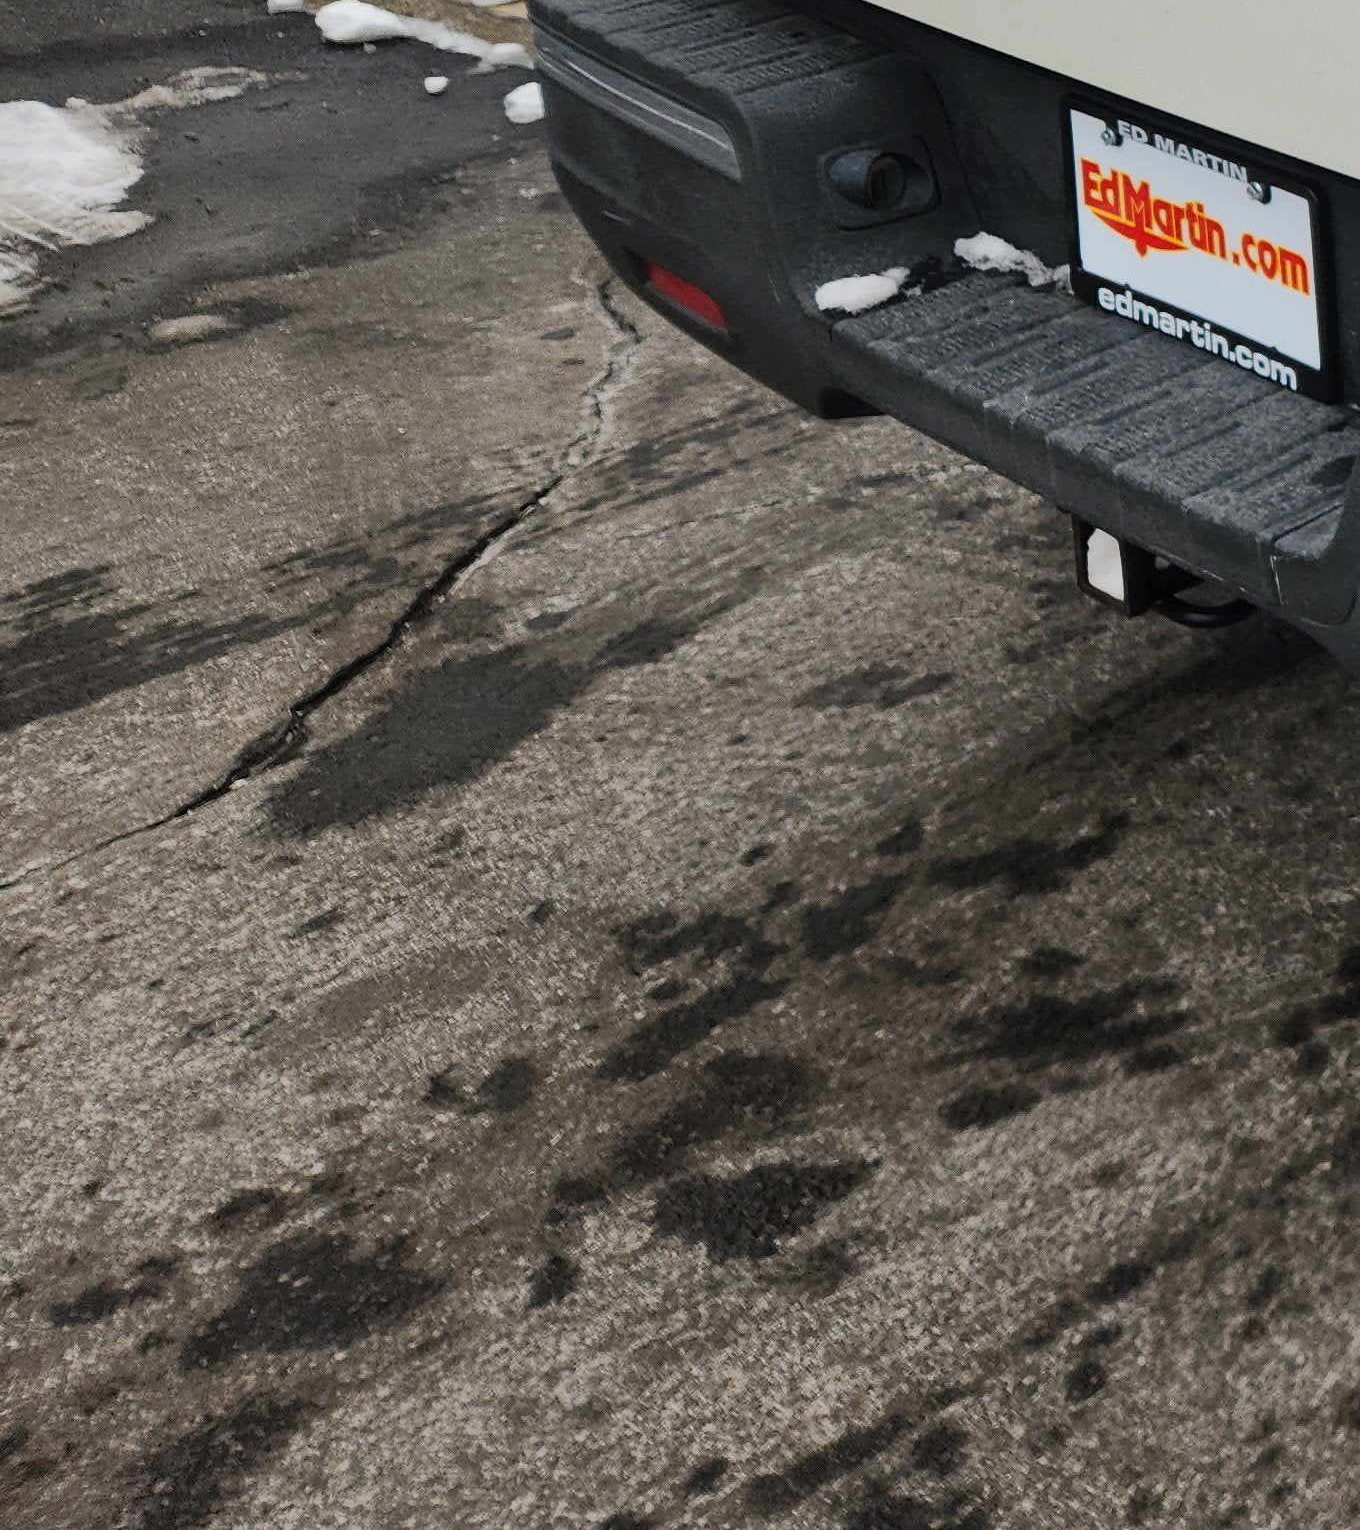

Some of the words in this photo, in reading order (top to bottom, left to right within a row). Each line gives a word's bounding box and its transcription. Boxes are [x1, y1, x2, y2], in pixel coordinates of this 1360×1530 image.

[1116, 119, 1149, 144] ED
[1153, 133, 1249, 182] MARTIN
[1097, 286, 1298, 392] edmartin.com
